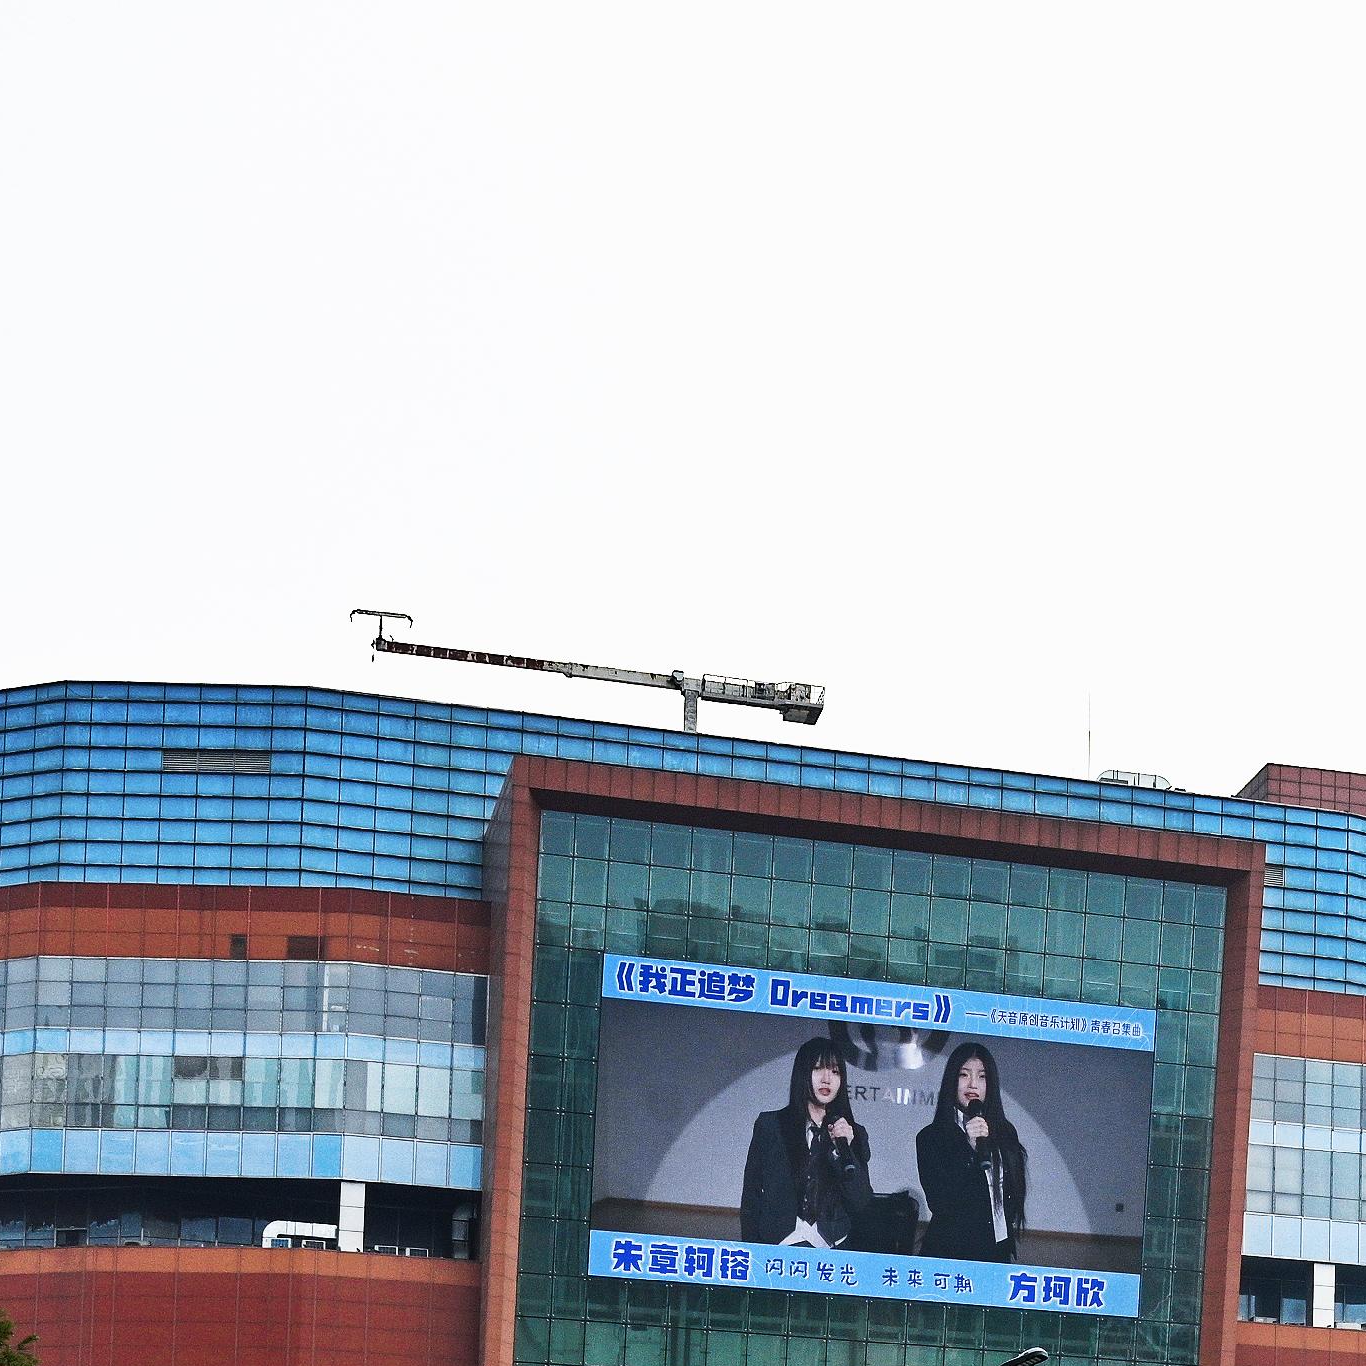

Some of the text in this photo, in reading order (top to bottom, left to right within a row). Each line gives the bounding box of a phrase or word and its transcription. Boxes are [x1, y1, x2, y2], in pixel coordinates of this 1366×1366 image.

[616, 961, 756, 1003] 《我正追梦
[765, 1258, 859, 1287] 闪闪发光
[881, 1267, 973, 1294] 未来可期
[1009, 1272, 1105, 1308] 方珂欣
